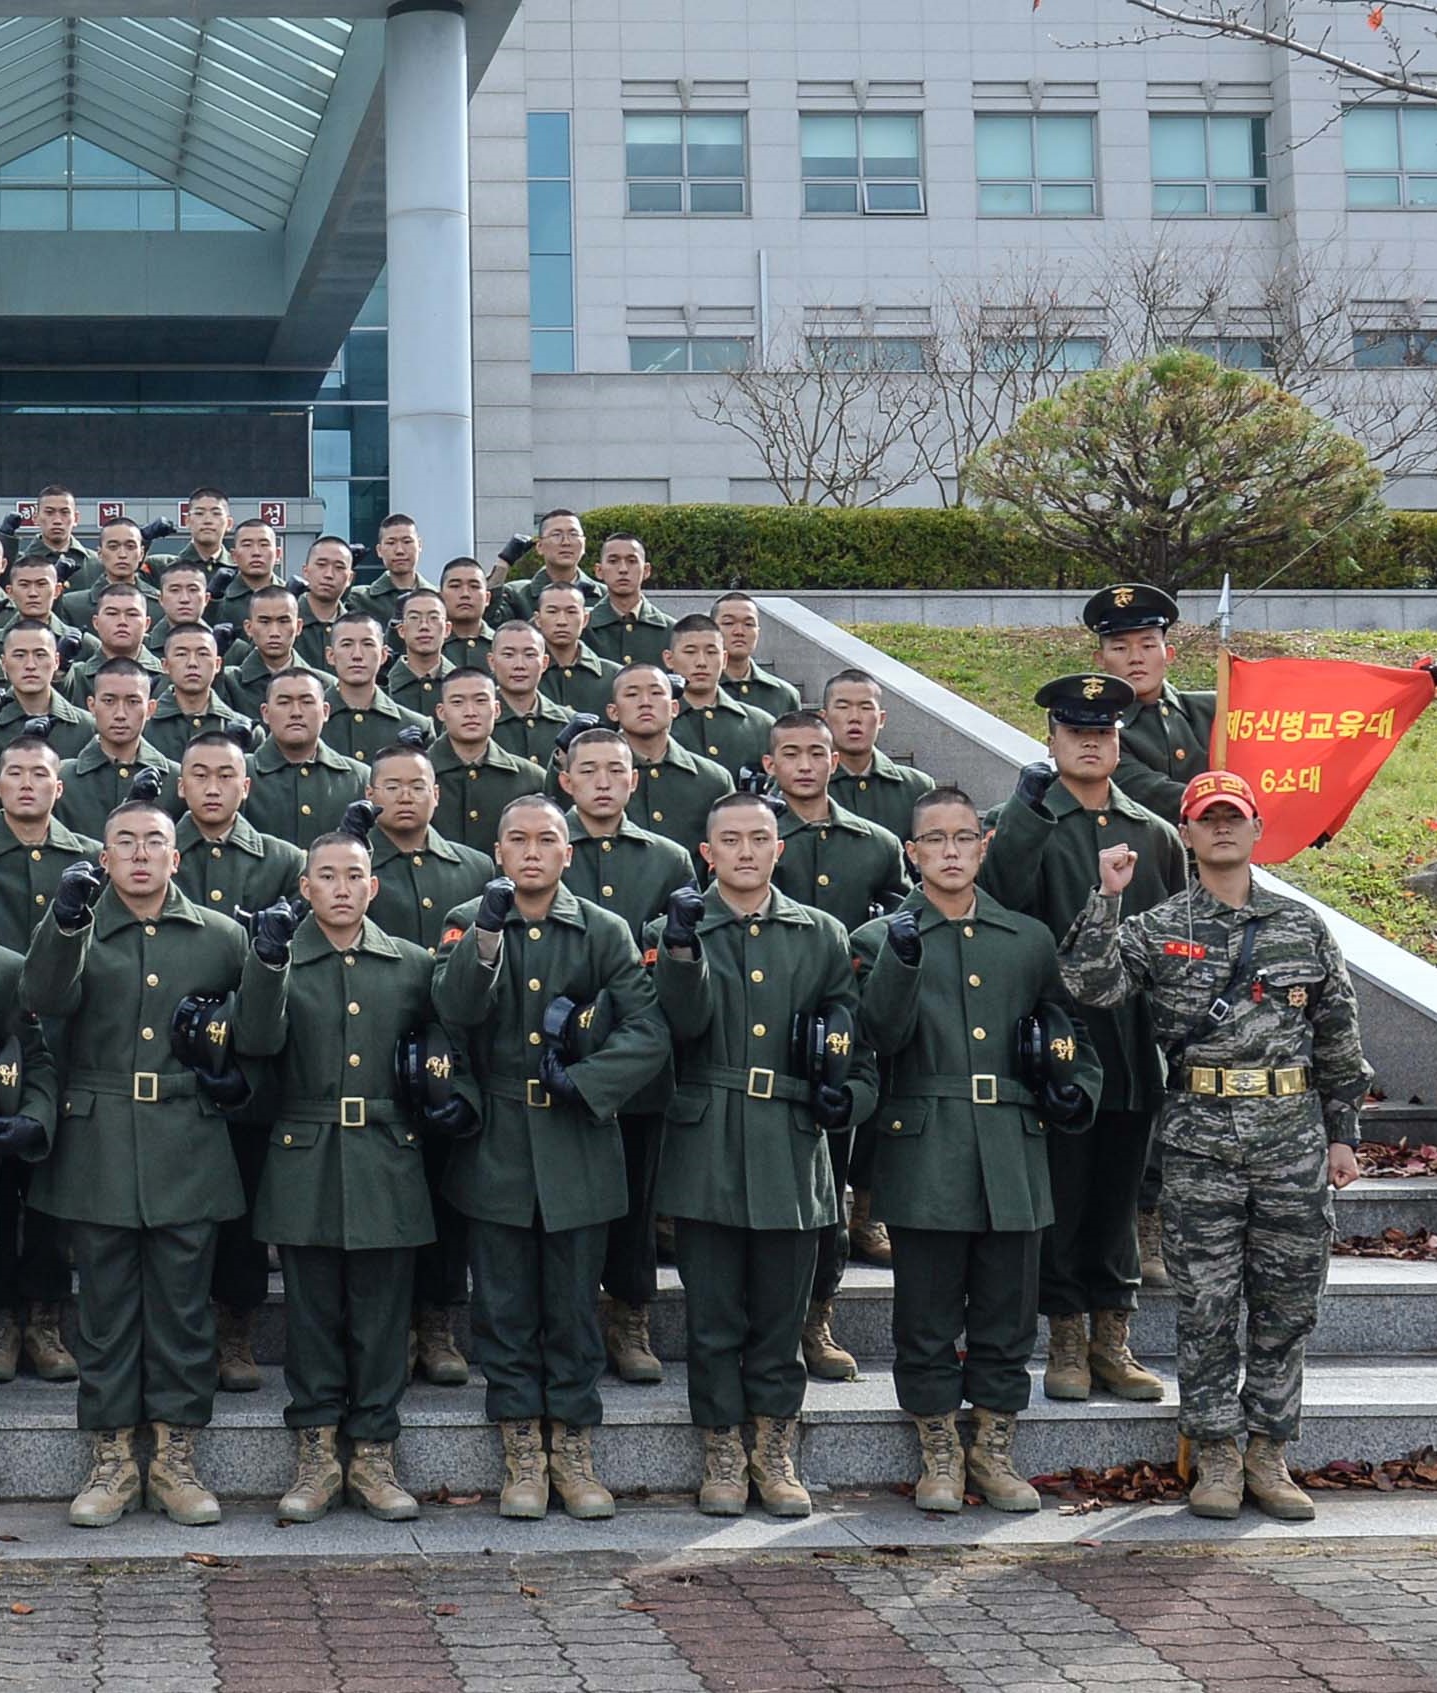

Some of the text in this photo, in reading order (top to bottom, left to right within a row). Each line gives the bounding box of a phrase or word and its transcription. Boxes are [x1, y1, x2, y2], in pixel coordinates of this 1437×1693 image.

[1226, 708, 1395, 742] 제5신병교육대
[1194, 776, 1244, 798] 교관
[1260, 765, 1322, 793] 6소대
